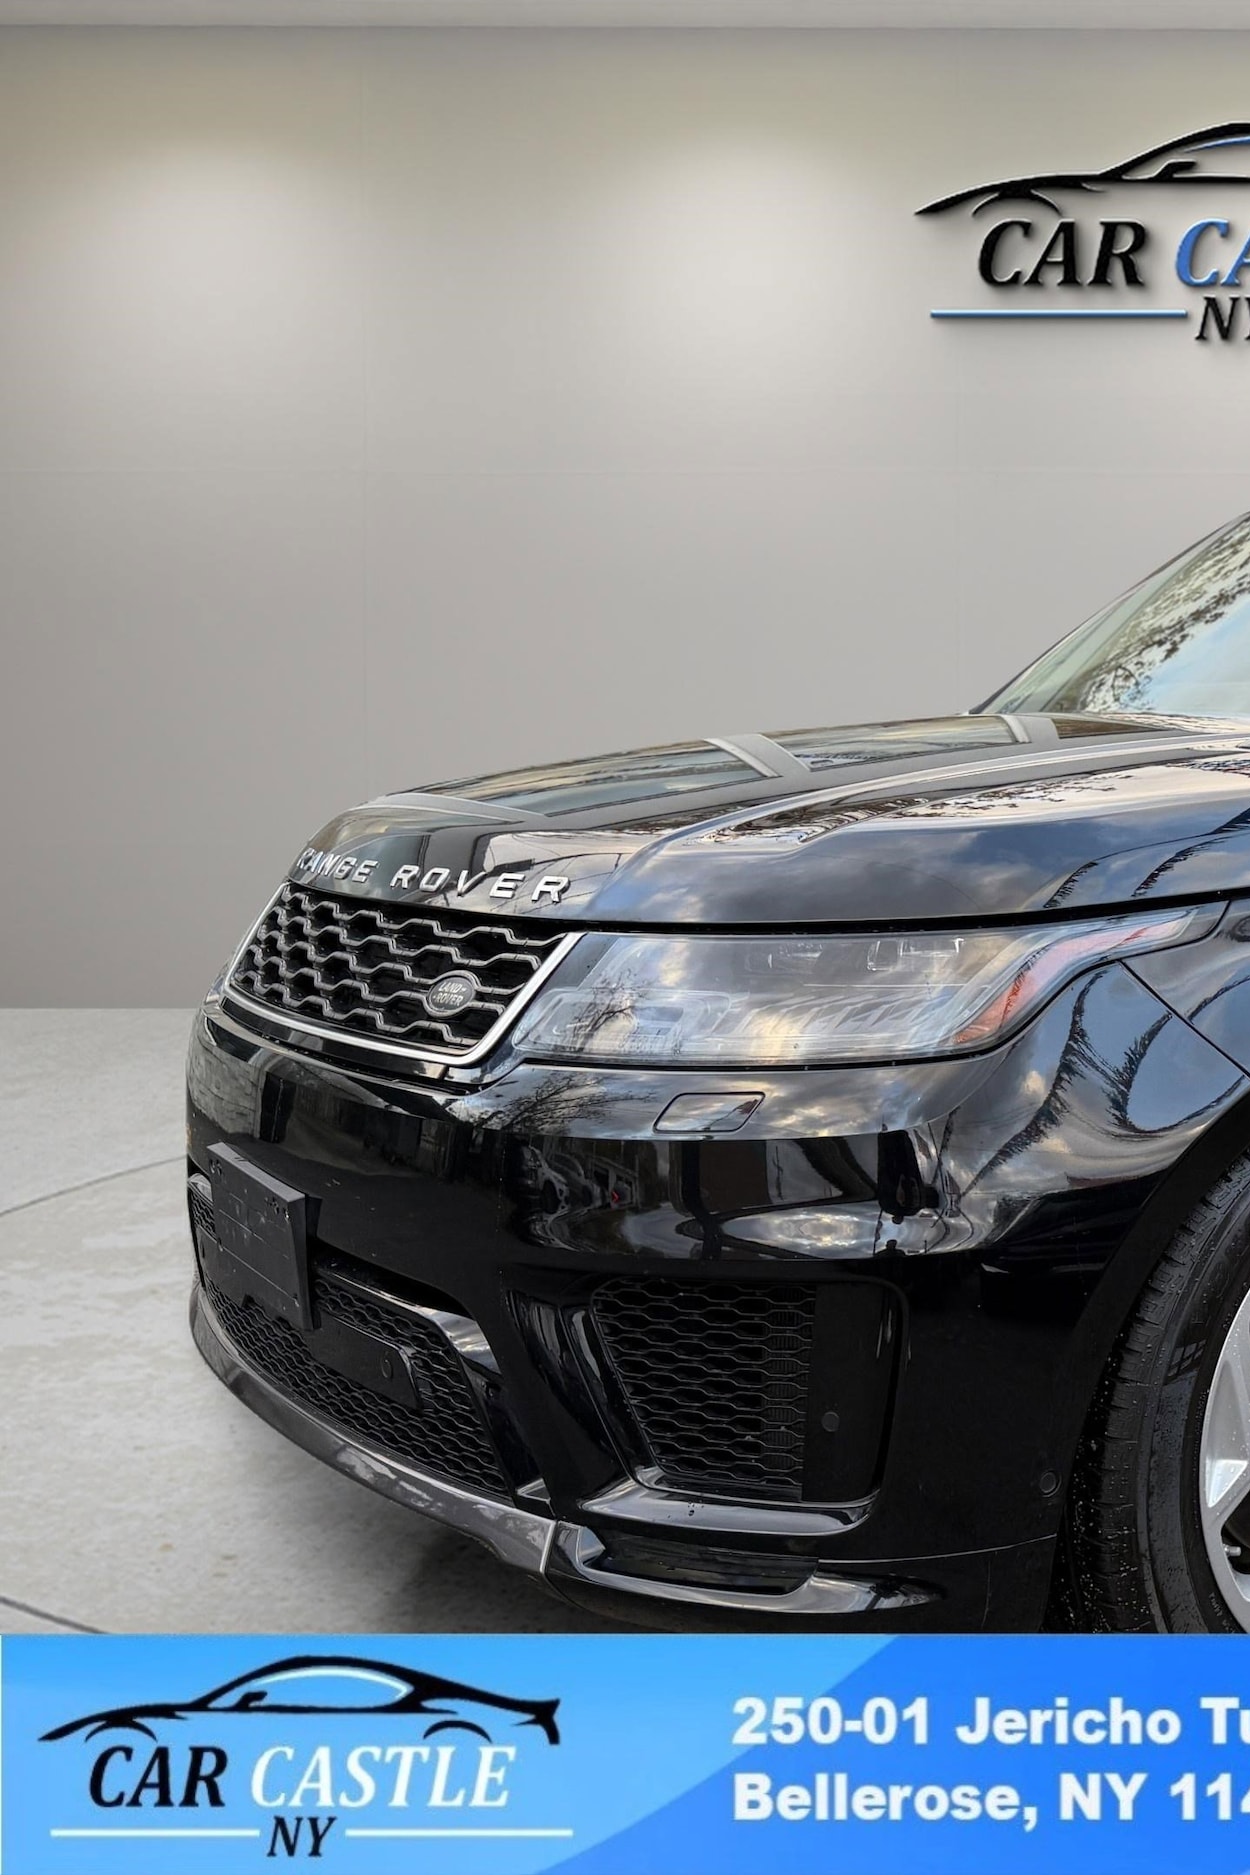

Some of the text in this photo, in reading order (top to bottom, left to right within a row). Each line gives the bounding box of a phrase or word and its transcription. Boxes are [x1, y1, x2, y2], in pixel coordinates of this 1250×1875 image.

[977, 218, 1147, 287] CAR
[296, 847, 571, 903] RANGE ROVER
